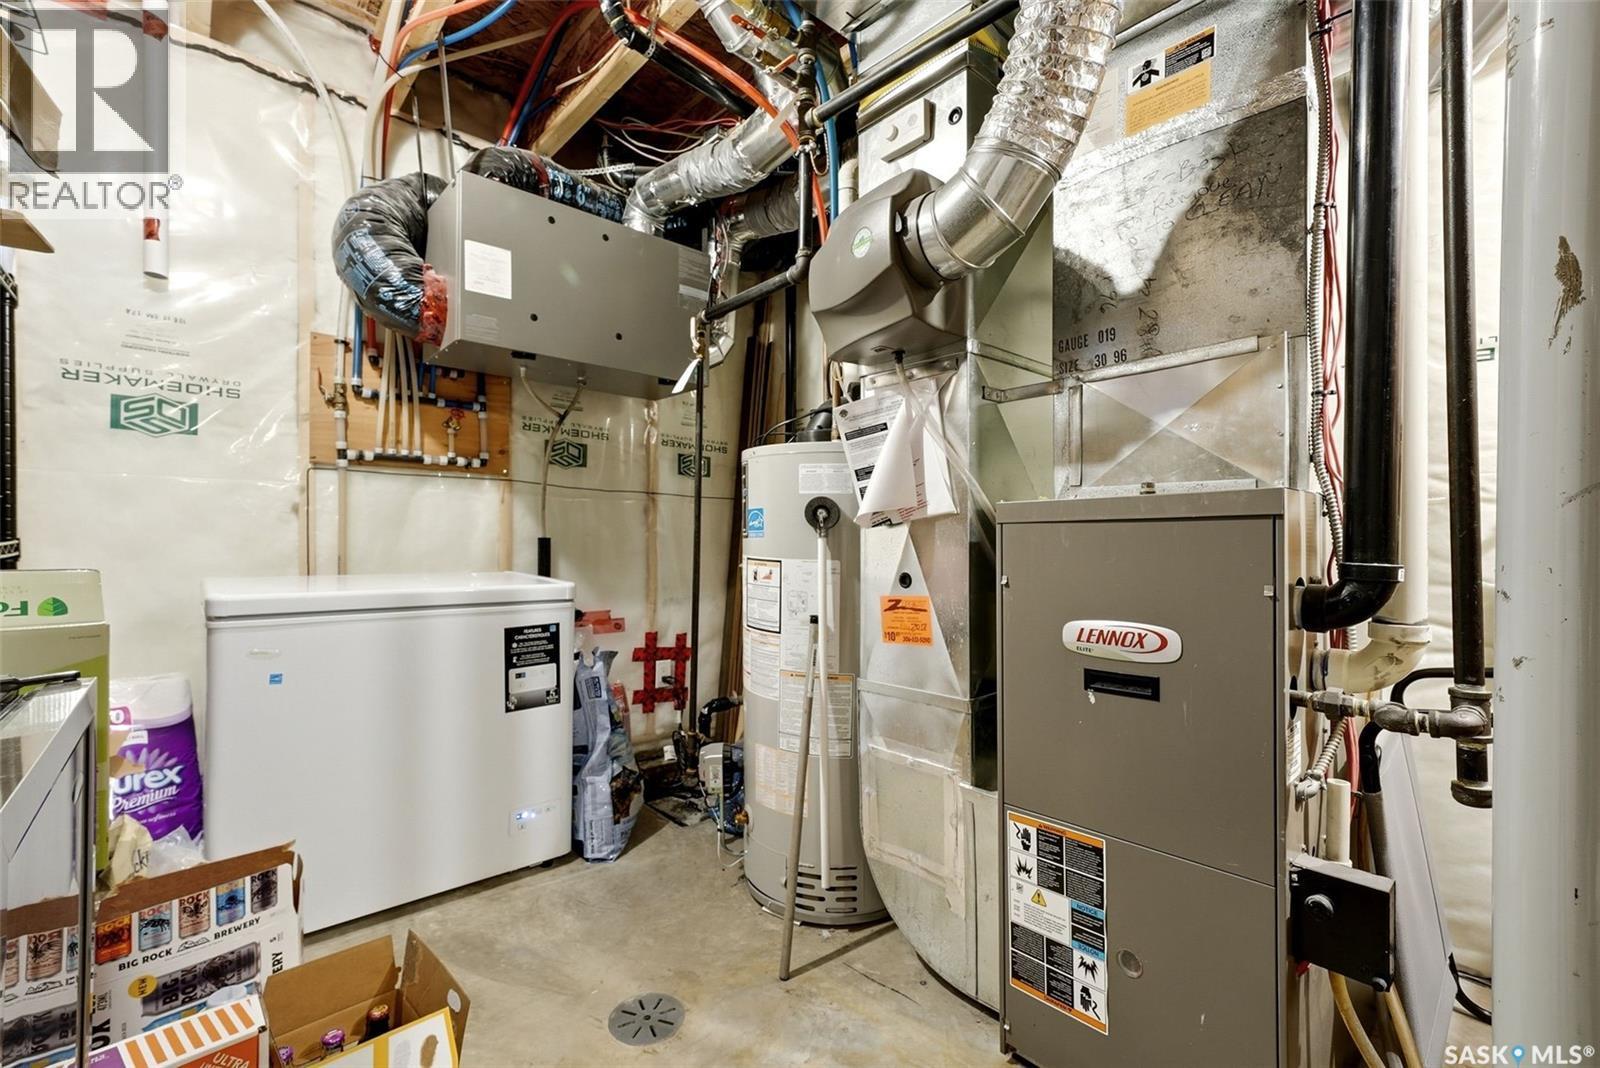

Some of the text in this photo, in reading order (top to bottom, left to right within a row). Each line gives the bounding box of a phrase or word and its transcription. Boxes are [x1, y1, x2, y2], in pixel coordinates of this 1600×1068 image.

[1058, 327, 1117, 353] GAUGE 019
[59, 357, 154, 377] SUPPLIES
[1058, 348, 1128, 375] SIZE 30 96
[61, 367, 241, 400] SHOEMAKER
[521, 421, 610, 441] SHOEMAKER
[661, 438, 729, 455] SHOMAKER
[1076, 627, 1149, 649] LENNOX
[1076, 645, 1092, 653] ELITE
[113, 764, 186, 795] urex
[111, 785, 181, 813] Premium
[179, 890, 210, 907] ROCK
[118, 958, 140, 972] BIG
[142, 948, 173, 964] ROCK
[214, 917, 261, 941] BREWERY
[162, 976, 180, 1006] BIG
[180, 963, 199, 1006] ROCK
